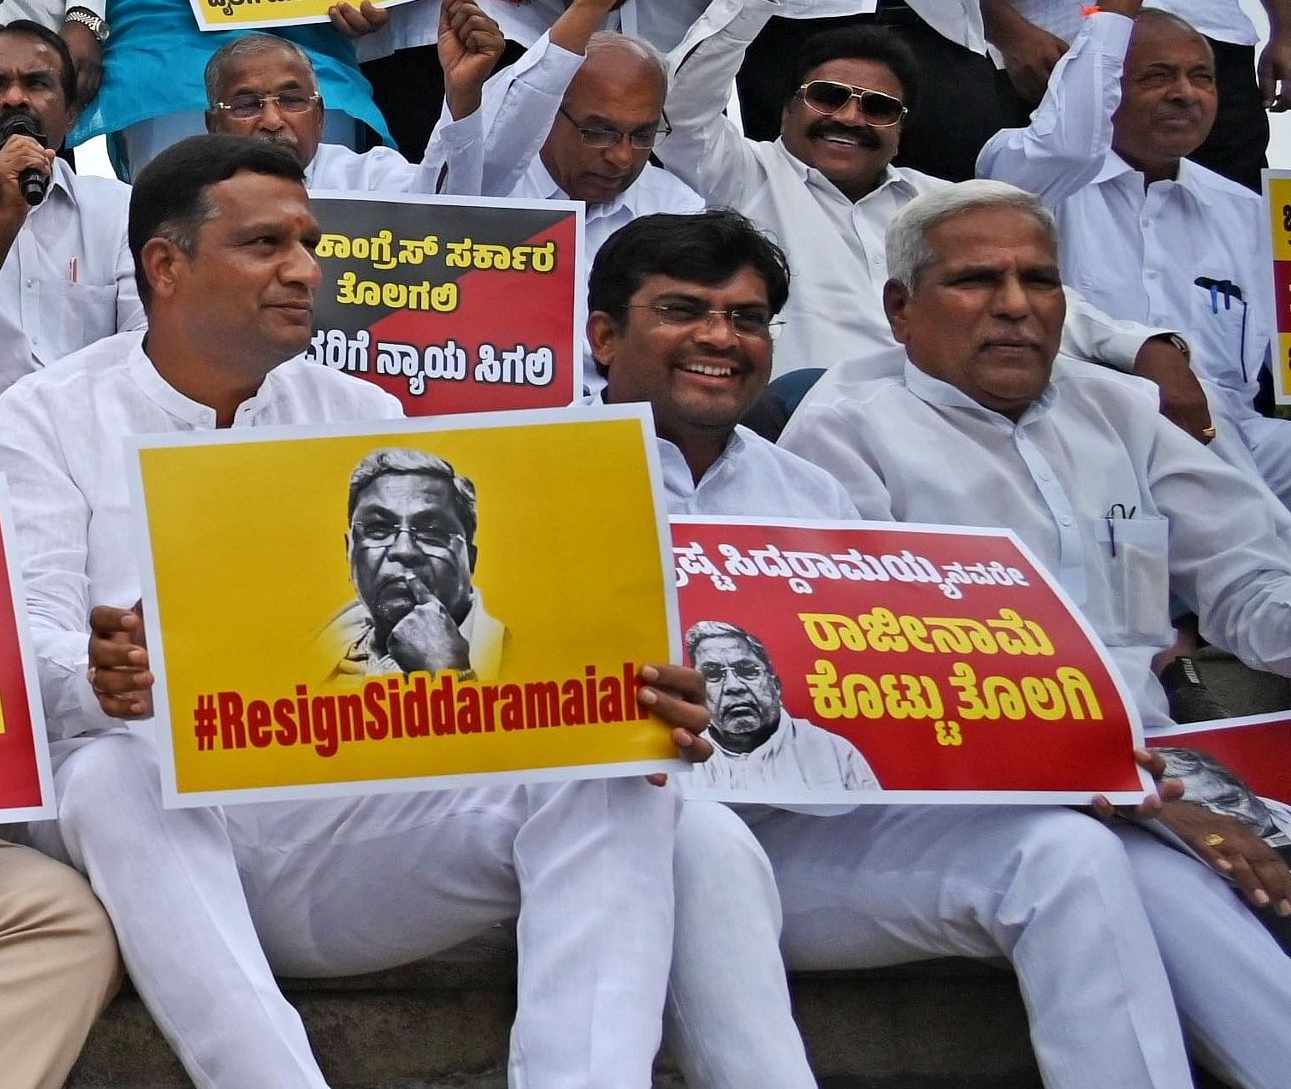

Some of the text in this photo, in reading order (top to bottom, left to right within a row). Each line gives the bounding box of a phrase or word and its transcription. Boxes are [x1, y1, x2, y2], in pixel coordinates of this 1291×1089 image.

[315, 230, 555, 272] ಕಾಂಗ್ರೆಸ್ ಸರ್ಕಾರ
[336, 271, 458, 312] ತೊಲಗಲಿ
[376, 341, 467, 395] ನ್ಯಾಯ
[474, 344, 553, 385] ಸಿಗಲಿ
[798, 606, 1056, 657] ರಾಜೀನಾಮೆ
[193, 661, 650, 758] #ResignSiddaramaiah
[805, 659, 1104, 747] ಕೊಟ್ಟು ತೊಲಗಿ
